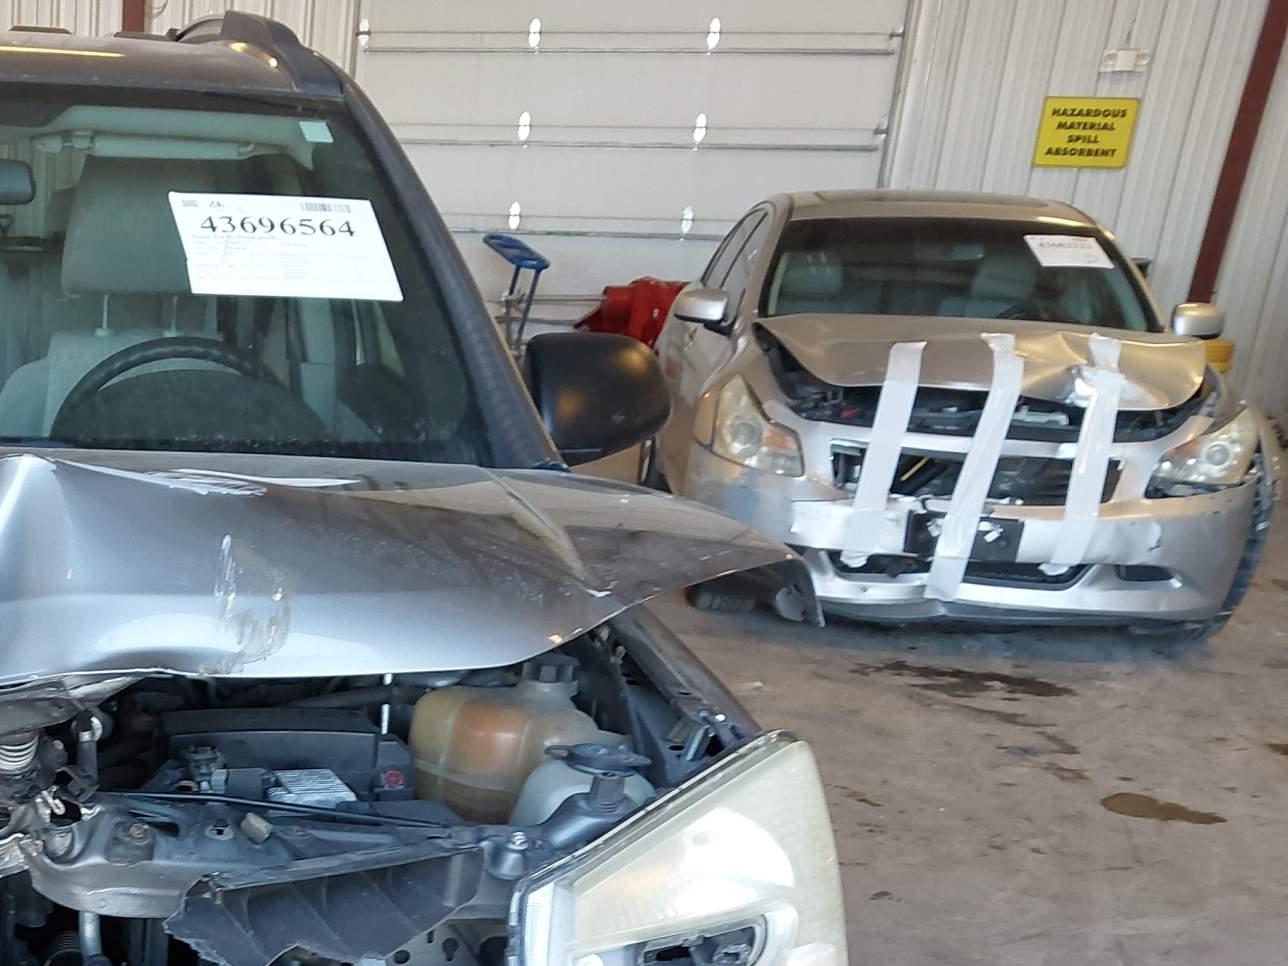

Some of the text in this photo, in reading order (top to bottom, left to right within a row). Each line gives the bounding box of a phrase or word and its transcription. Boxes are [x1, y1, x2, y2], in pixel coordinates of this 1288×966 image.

[1052, 108, 1128, 118] HAZARDOUS
[1056, 122, 1116, 131] MATERIAL
[1067, 134, 1100, 143] SPILL
[1045, 147, 1117, 157] ABSORBENT
[200, 215, 356, 237] 43696564
